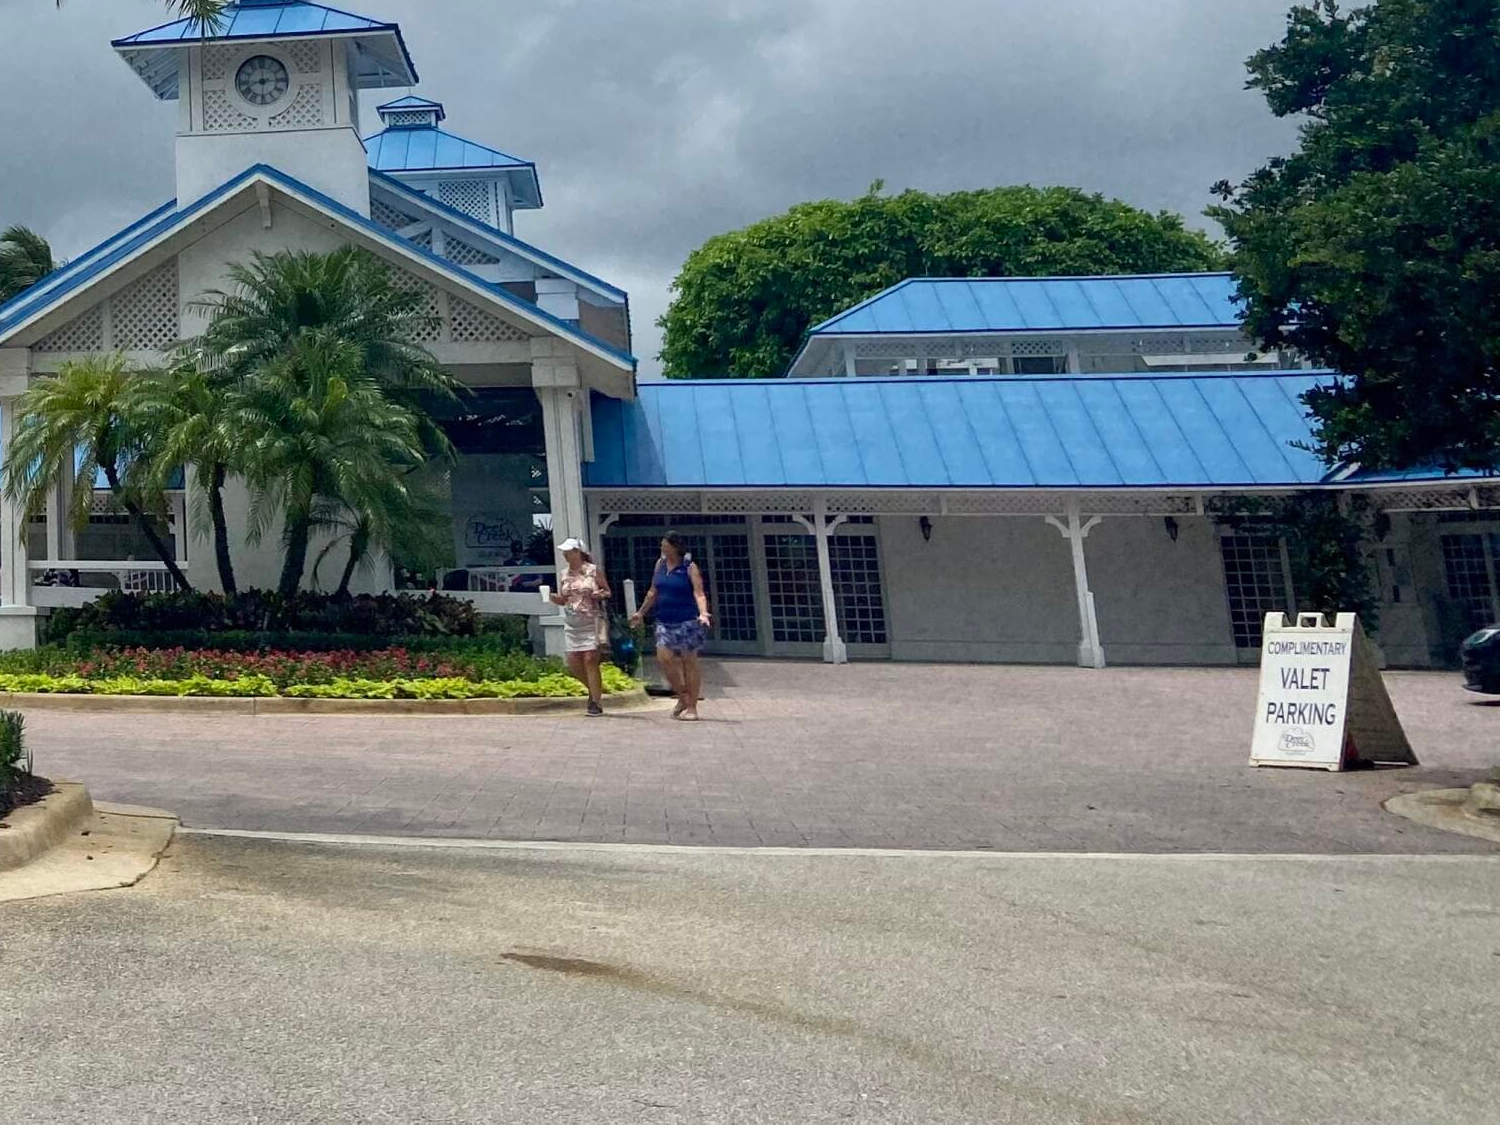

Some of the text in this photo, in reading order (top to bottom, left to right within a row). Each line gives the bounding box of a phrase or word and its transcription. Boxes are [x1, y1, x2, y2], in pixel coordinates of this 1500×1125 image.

[1267, 641, 1348, 655] COMPLIMENTARY
[1280, 667, 1330, 690] VALET
[1266, 702, 1337, 725] PARKING
